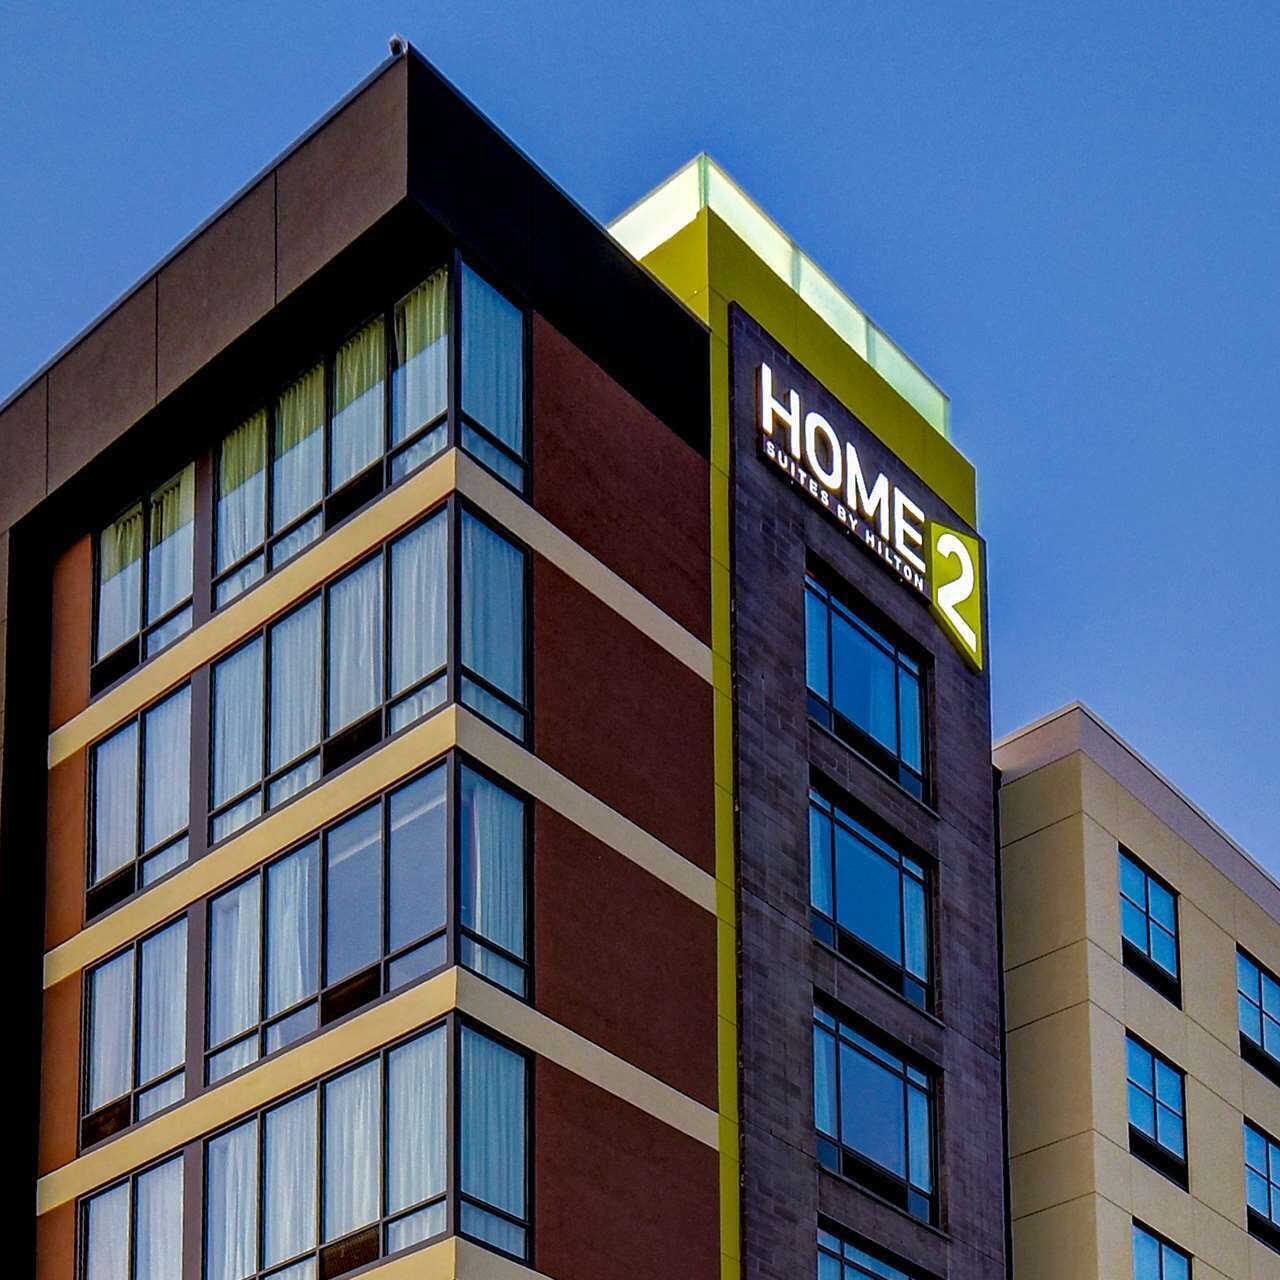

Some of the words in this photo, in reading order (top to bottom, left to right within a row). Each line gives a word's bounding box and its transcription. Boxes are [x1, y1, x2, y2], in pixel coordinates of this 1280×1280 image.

[766, 441, 829, 506] SUITES
[837, 504, 858, 532] BY
[865, 529, 924, 591] HILTON
